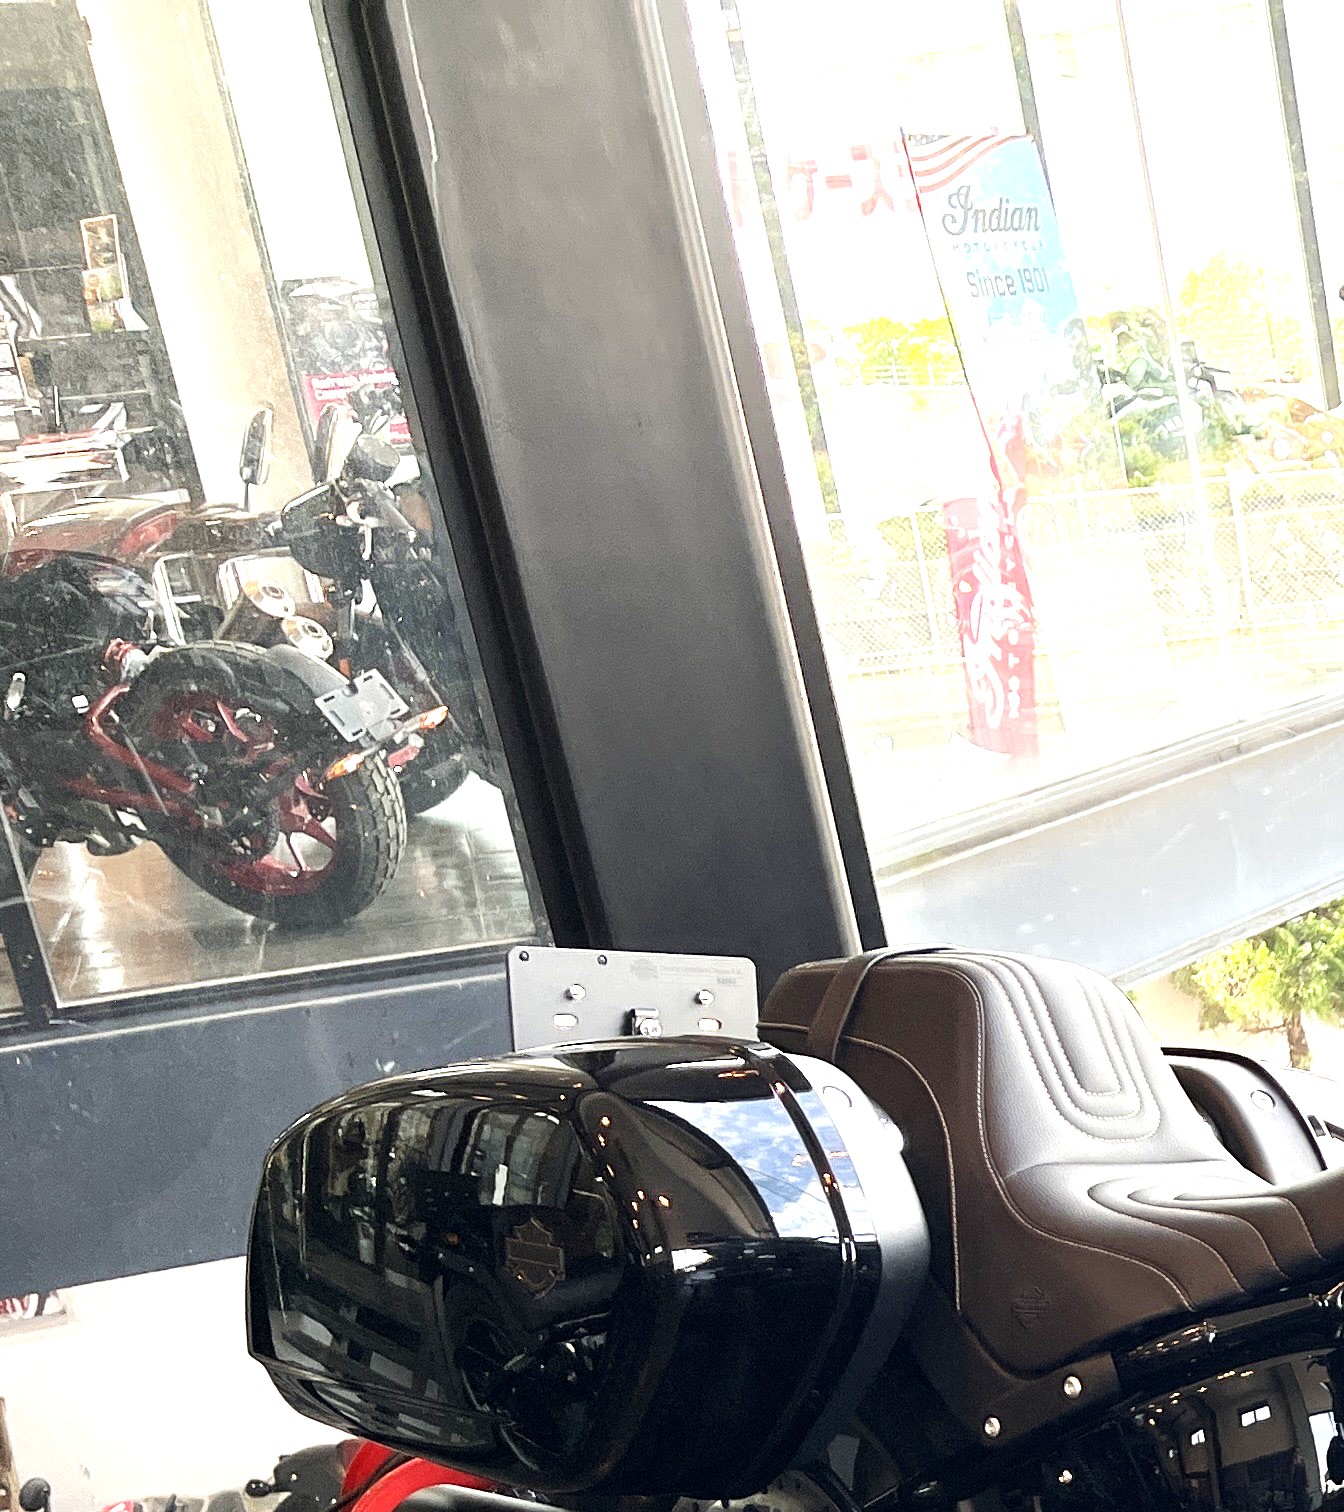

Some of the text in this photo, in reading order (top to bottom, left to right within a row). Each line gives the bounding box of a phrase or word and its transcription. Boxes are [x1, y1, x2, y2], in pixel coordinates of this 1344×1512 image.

[941, 185, 1041, 236] Indian
[966, 266, 1050, 298] Since 1901
